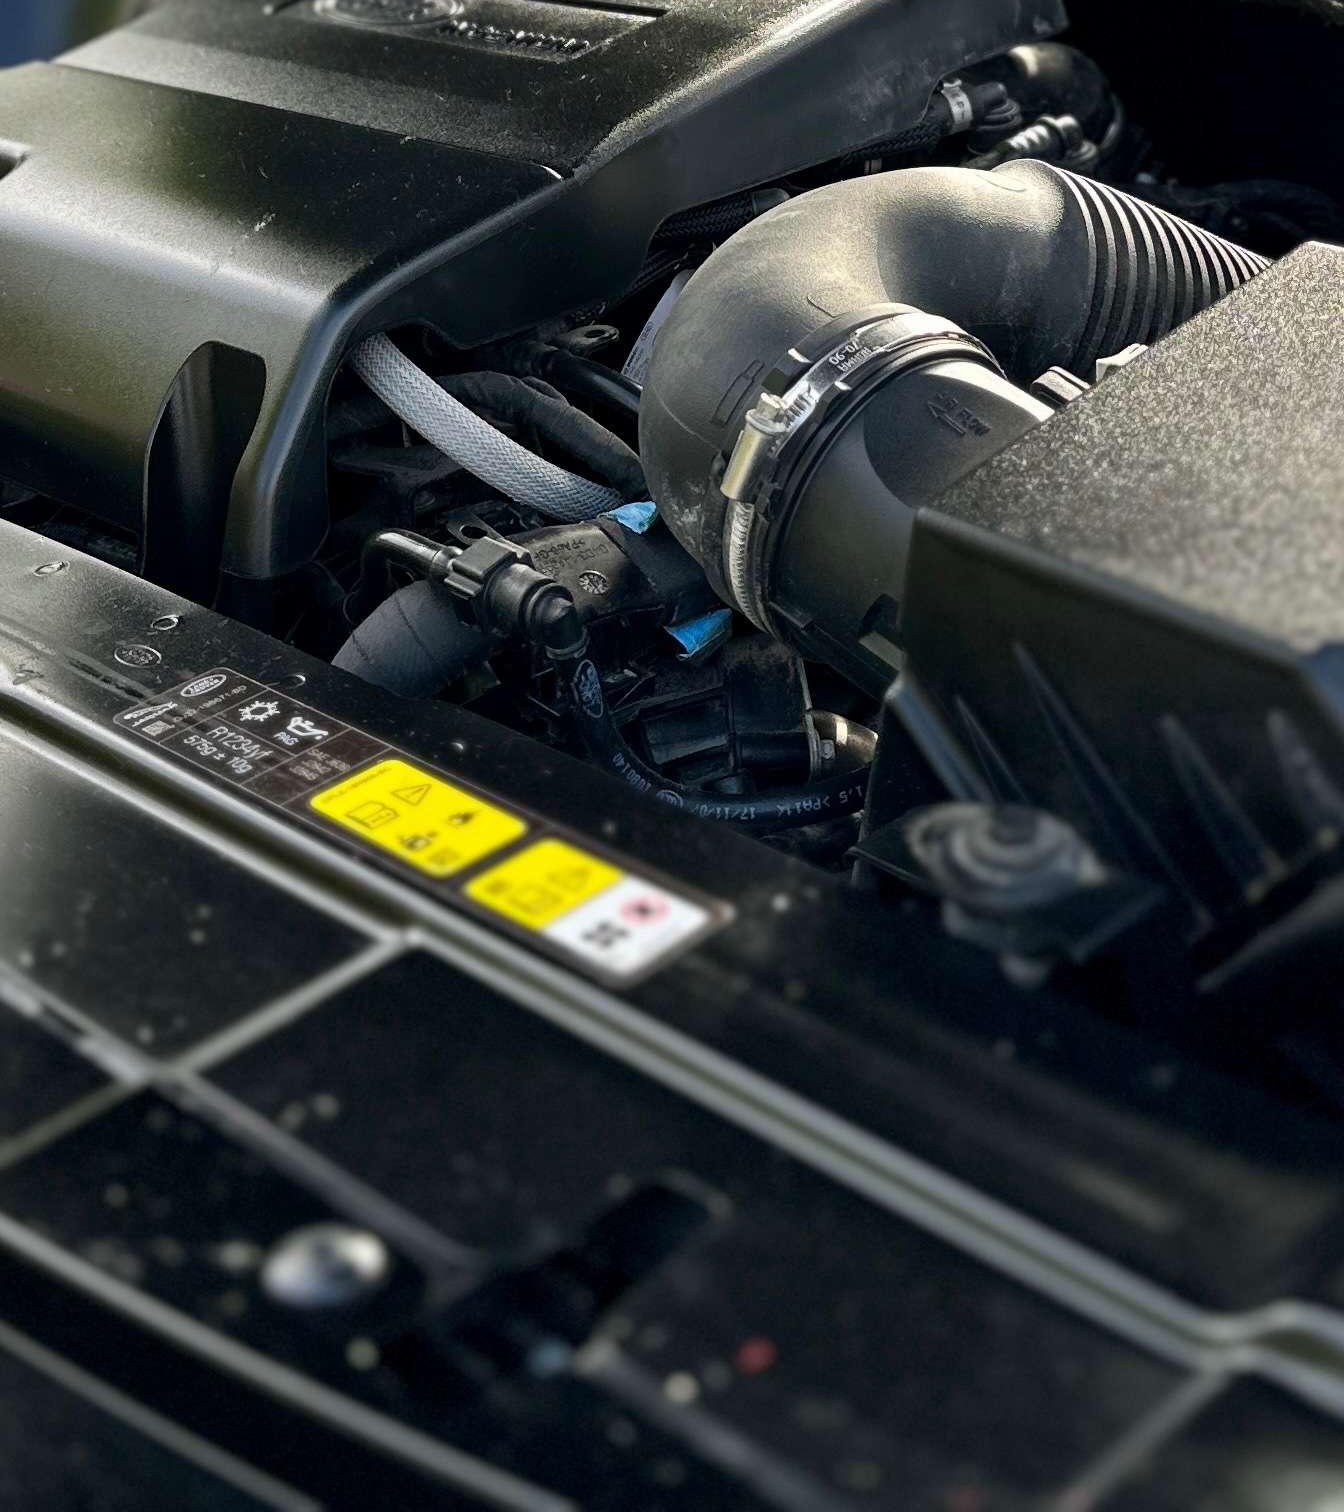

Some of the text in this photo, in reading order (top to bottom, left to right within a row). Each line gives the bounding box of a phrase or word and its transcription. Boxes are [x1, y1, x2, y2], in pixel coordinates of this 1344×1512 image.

[183, 735, 217, 756] 575g
[226, 753, 253, 775] 10g
[206, 726, 273, 760] R1234yf
[272, 730, 300, 747] PAG
